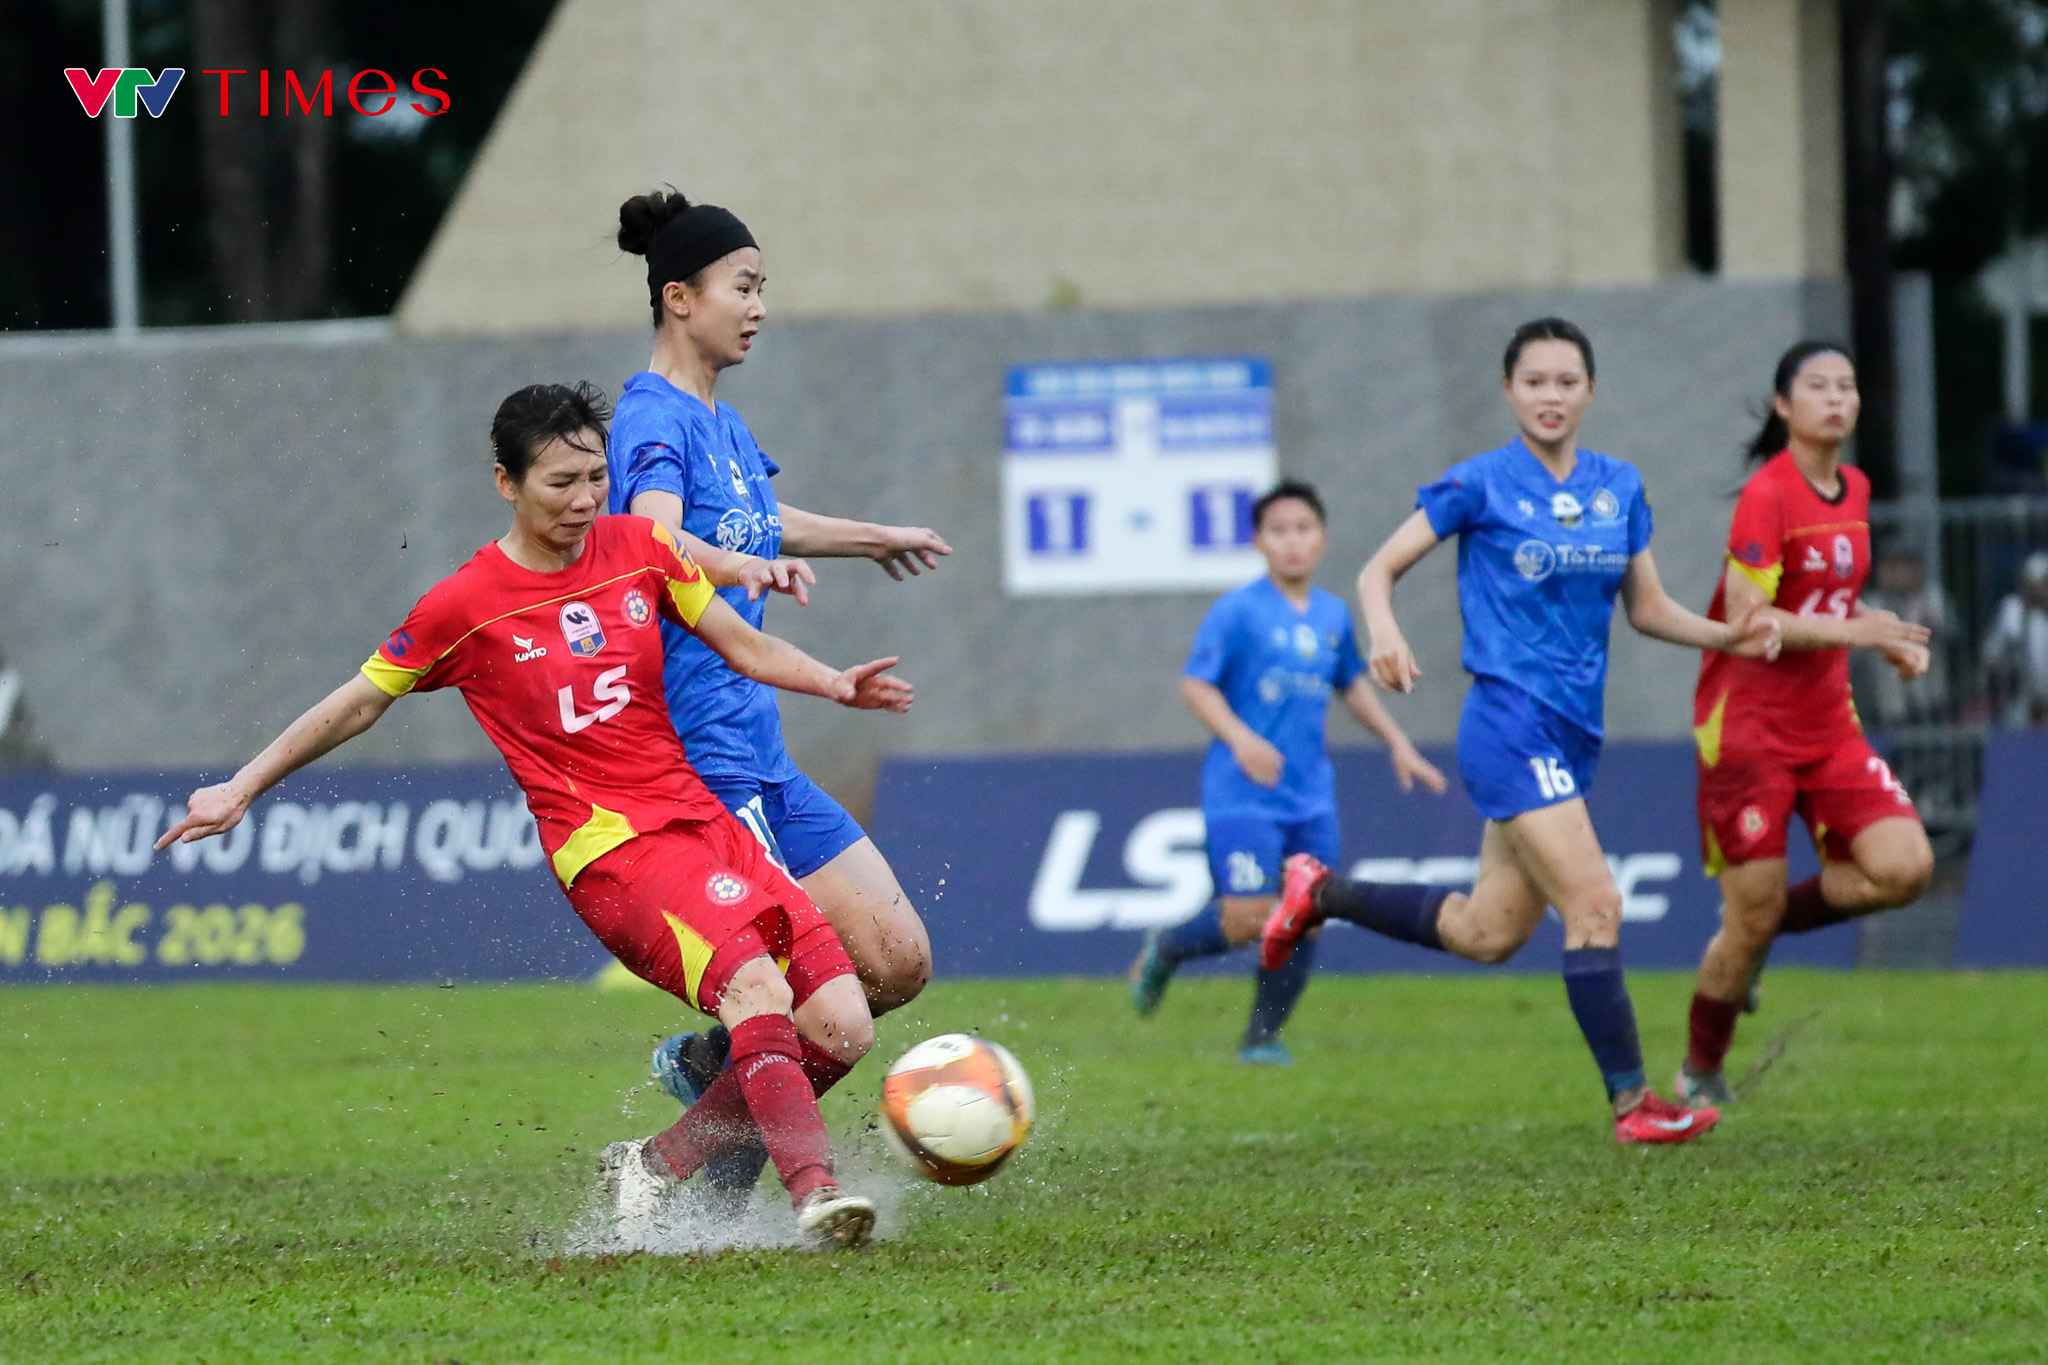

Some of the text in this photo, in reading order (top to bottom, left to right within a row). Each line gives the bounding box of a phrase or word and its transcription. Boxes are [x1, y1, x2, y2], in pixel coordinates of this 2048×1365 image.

[514, 647, 547, 663] KAMITO
[558, 665, 632, 734] LS
[1530, 757, 1575, 800] 16
[1029, 809, 1214, 931] LS
[157, 905, 305, 966] 2026
